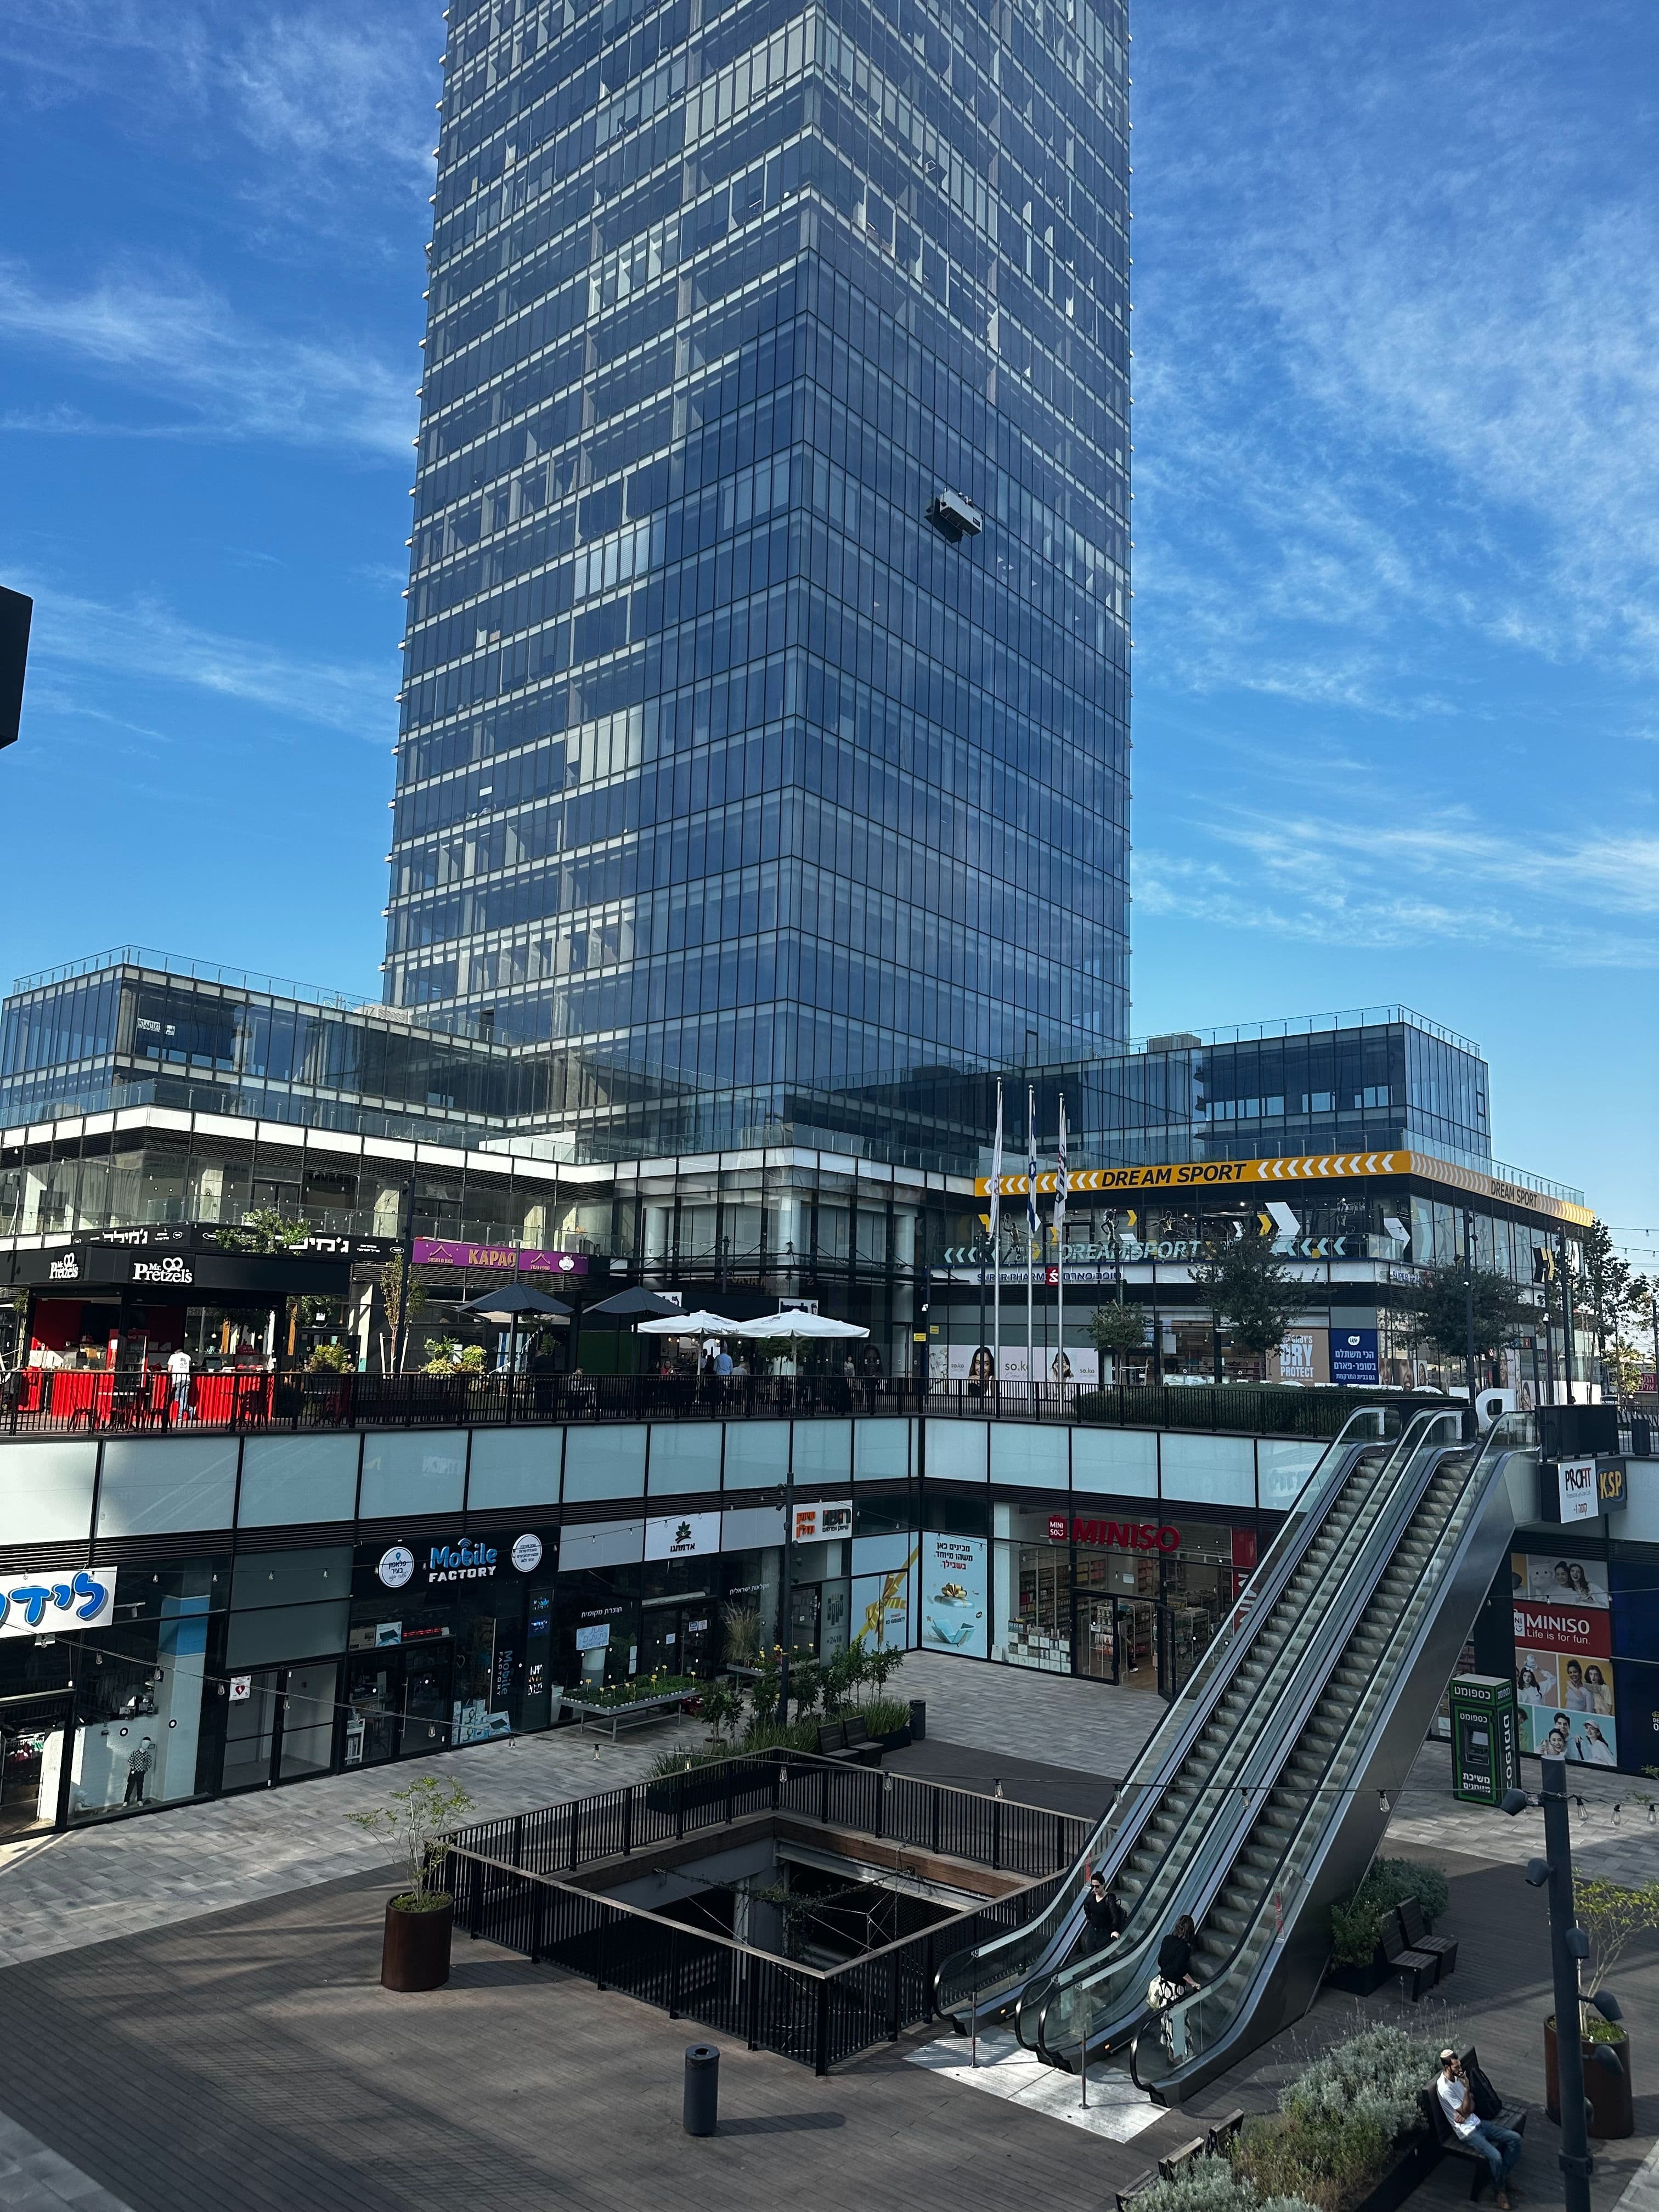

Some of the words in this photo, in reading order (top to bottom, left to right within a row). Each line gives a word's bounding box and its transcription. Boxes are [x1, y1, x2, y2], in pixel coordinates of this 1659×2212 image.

[1102, 1168, 1172, 1187] DREAM
[1177, 1164, 1246, 1183] SPORT
[1491, 1180, 1515, 1201] DREAM
[1516, 1189, 1537, 1207] SPORT
[1279, 1344, 1313, 1366] DRY
[1335, 1349, 1362, 1359] משתלם
[1363, 1351, 1374, 1359] הכי
[1280, 1366, 1314, 1378] PROTECT
[1334, 1362, 1376, 1371] בסופר-פארם
[1072, 1517, 1181, 1552] MINISO
[670, 1543, 695, 1552] אדמתנו
[936, 1542, 948, 1550] כאן
[949, 1543, 970, 1552] מכינים
[430, 1543, 498, 1570] Mobile
[956, 1553, 973, 1562] משהו
[428, 1566, 496, 1582] FACTORY
[581, 1609, 603, 1618] מקומית
[604, 1606, 622, 1615] תוצרת
[1526, 1613, 1590, 1634] MINISO
[1527, 1628, 1543, 1639] Life
[1547, 1631, 1554, 1640] is
[1558, 1633, 1570, 1642] for
[1573, 1635, 1591, 1645] fun.
[501, 1650, 513, 1695] Mobile
[1454, 1686, 1491, 1700] כספומט
[1460, 1713, 1487, 1723] כספומט
[1503, 1714, 1512, 1789] כספומט
[1463, 1773, 1490, 1784] משיכת
[1463, 1782, 1491, 1793] מזומנים
